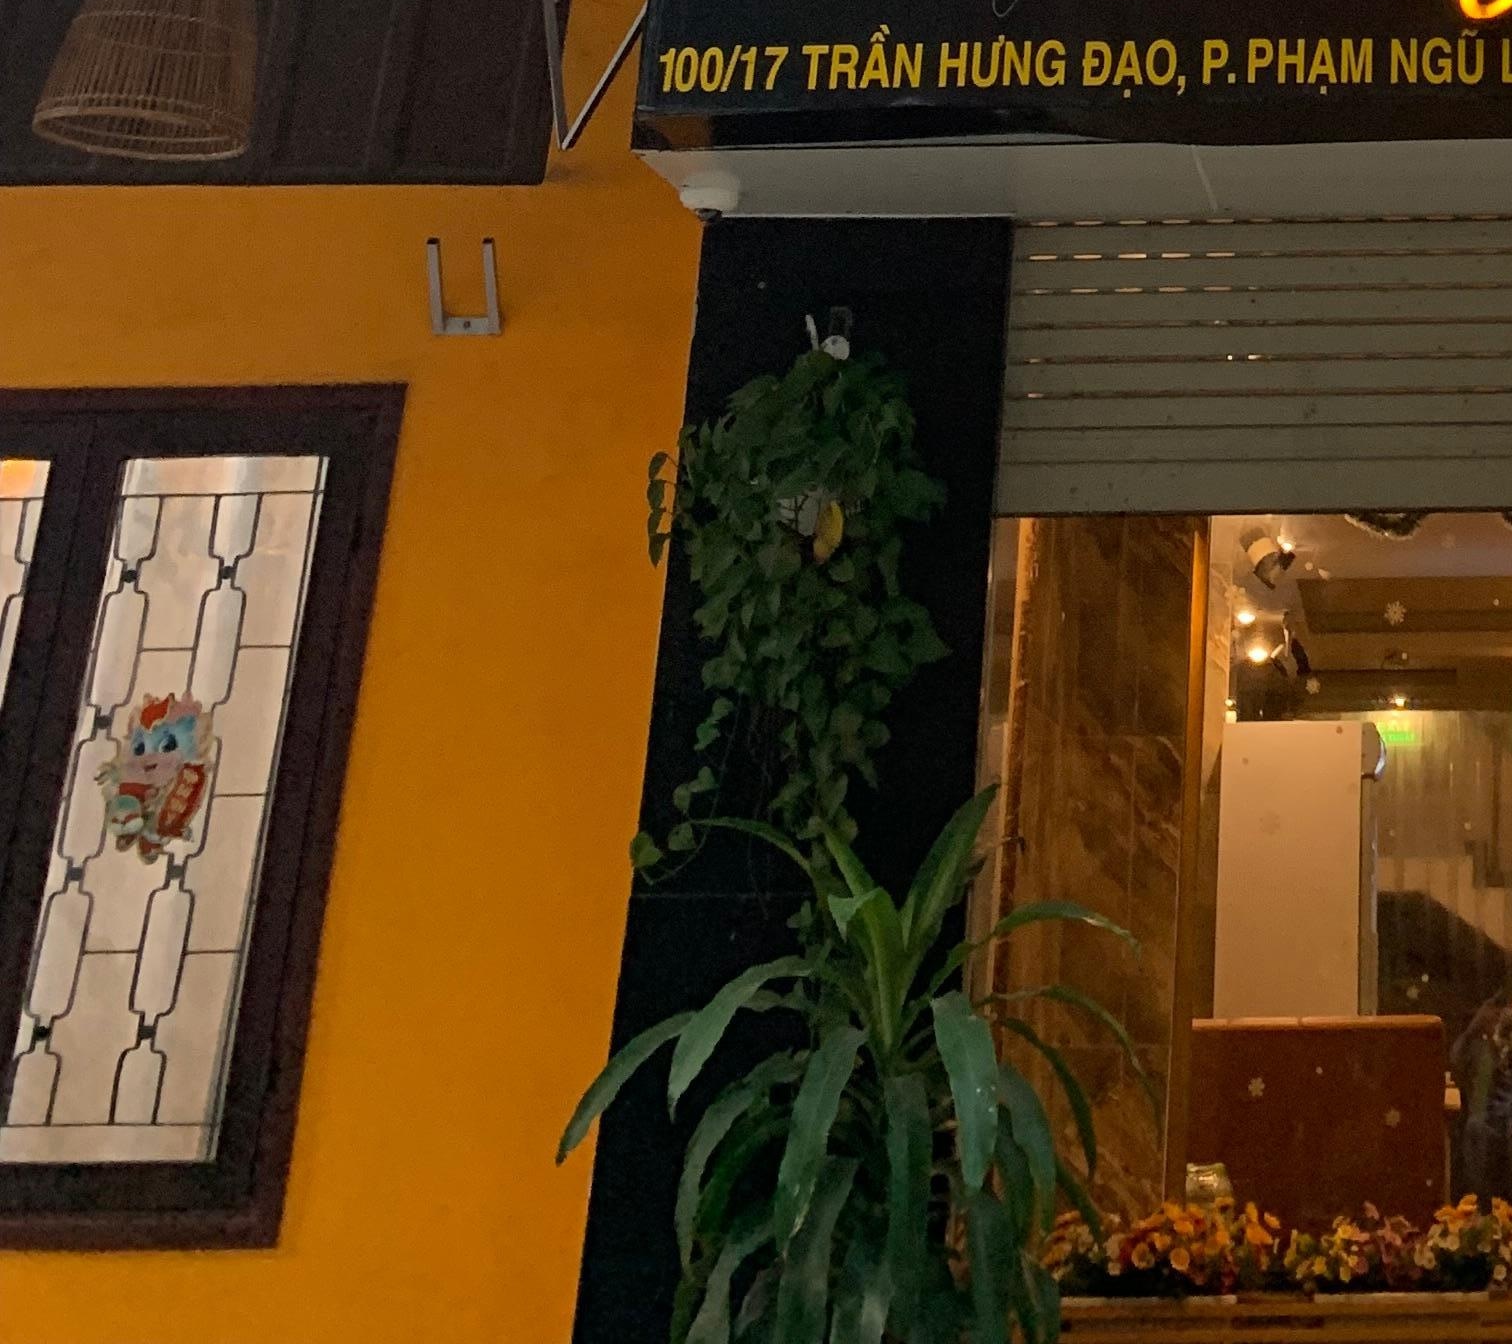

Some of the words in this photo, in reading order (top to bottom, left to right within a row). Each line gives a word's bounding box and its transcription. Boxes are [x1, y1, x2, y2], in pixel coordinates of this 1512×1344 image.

[659, 45, 789, 93] 100/17
[801, 24, 924, 91] TRẦN
[937, 35, 1066, 88] HƯNG
[1081, 38, 1186, 98] ĐẠO,
[1390, 28, 1485, 85] NGŨ
